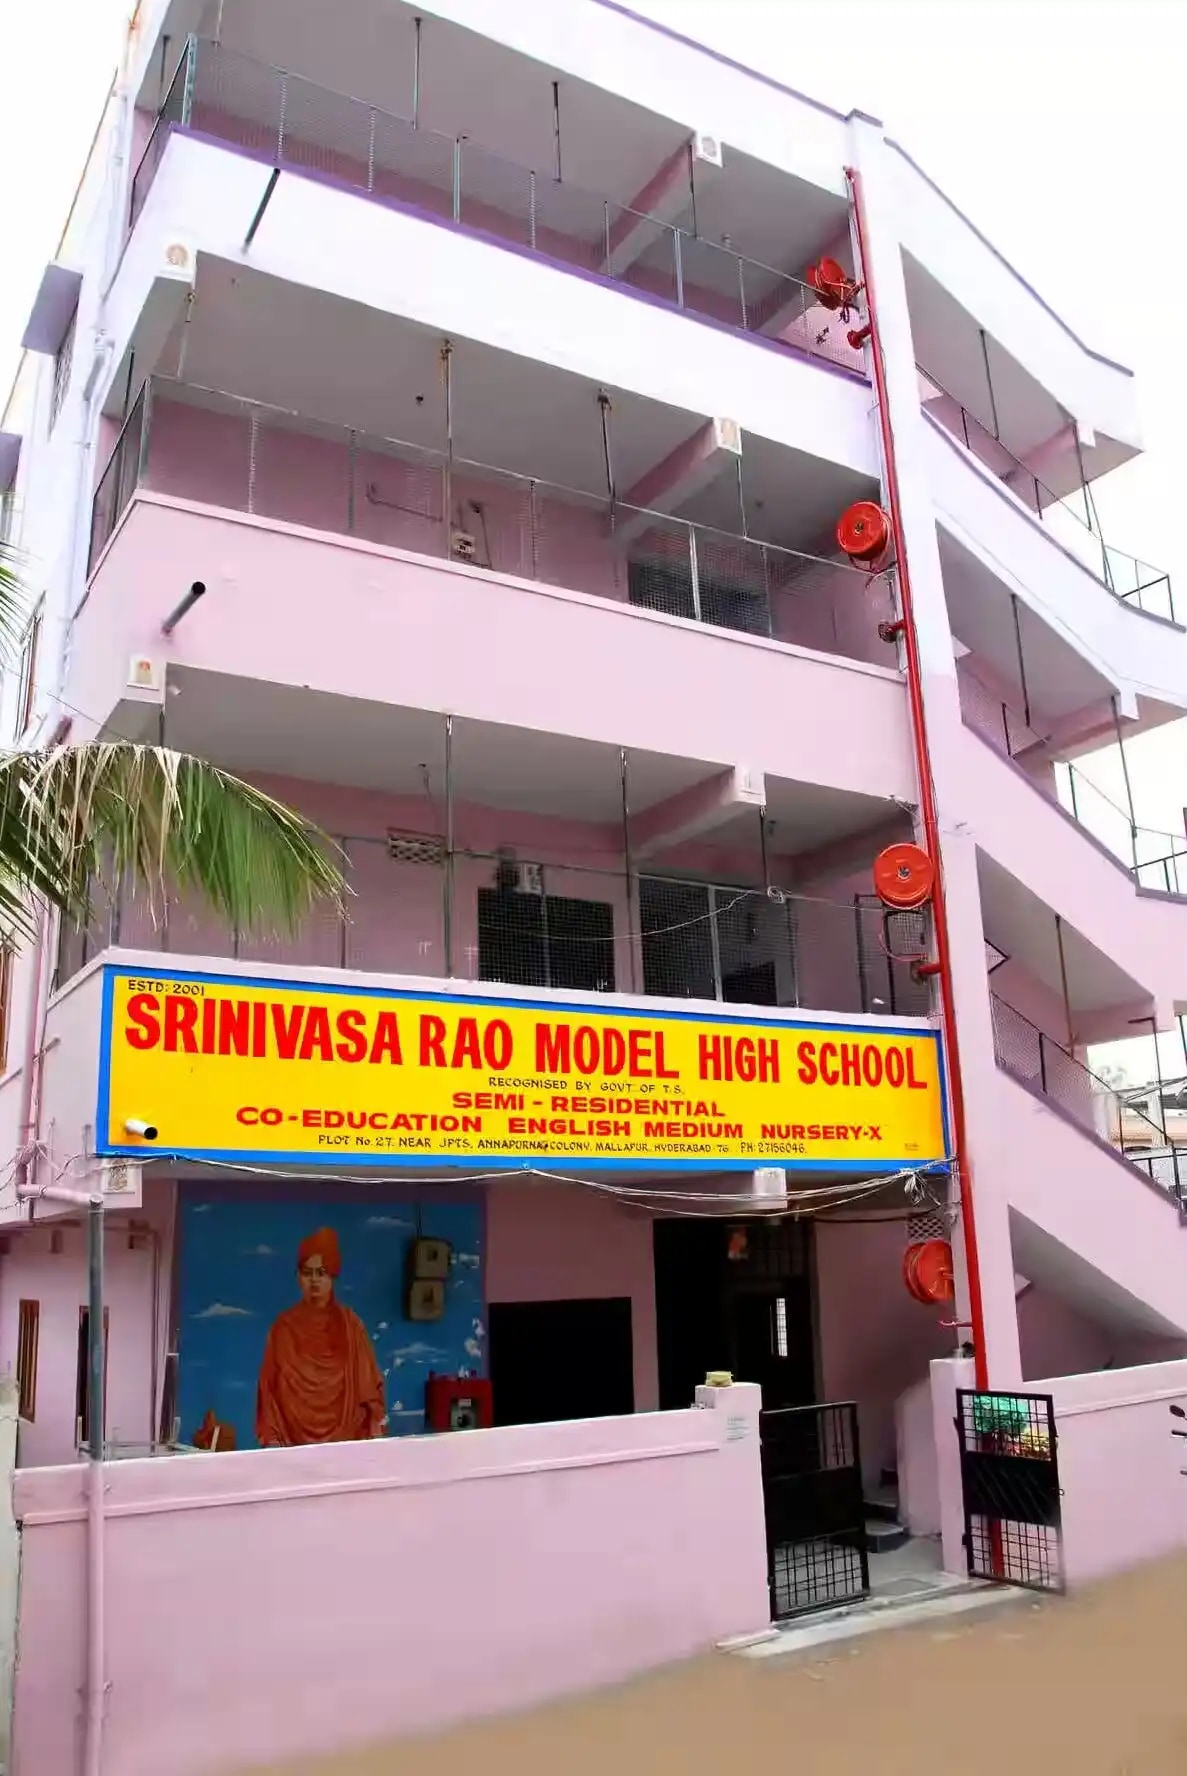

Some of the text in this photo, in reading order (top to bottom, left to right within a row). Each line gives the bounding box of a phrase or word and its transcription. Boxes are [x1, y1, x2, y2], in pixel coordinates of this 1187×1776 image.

[128, 979, 205, 996] ESTD: 2001
[125, 992, 928, 1090] SRINIVASA RAO MODEL HIGH SCHOOL
[488, 1076, 568, 1090] RECOGNISED
[575, 1081, 592, 1091] BY
[639, 1084, 656, 1094] OF
[452, 1091, 525, 1112] SEMI
[551, 1095, 726, 1118] RESIDENTIAL
[236, 1106, 882, 1141] CO-EDUCATION ENGLISH MEDIUM NURSERY-X
[318, 1134, 350, 1145] PLOT
[398, 1137, 432, 1148] NEAR
[477, 1138, 545, 1150] ANNAPURNA
